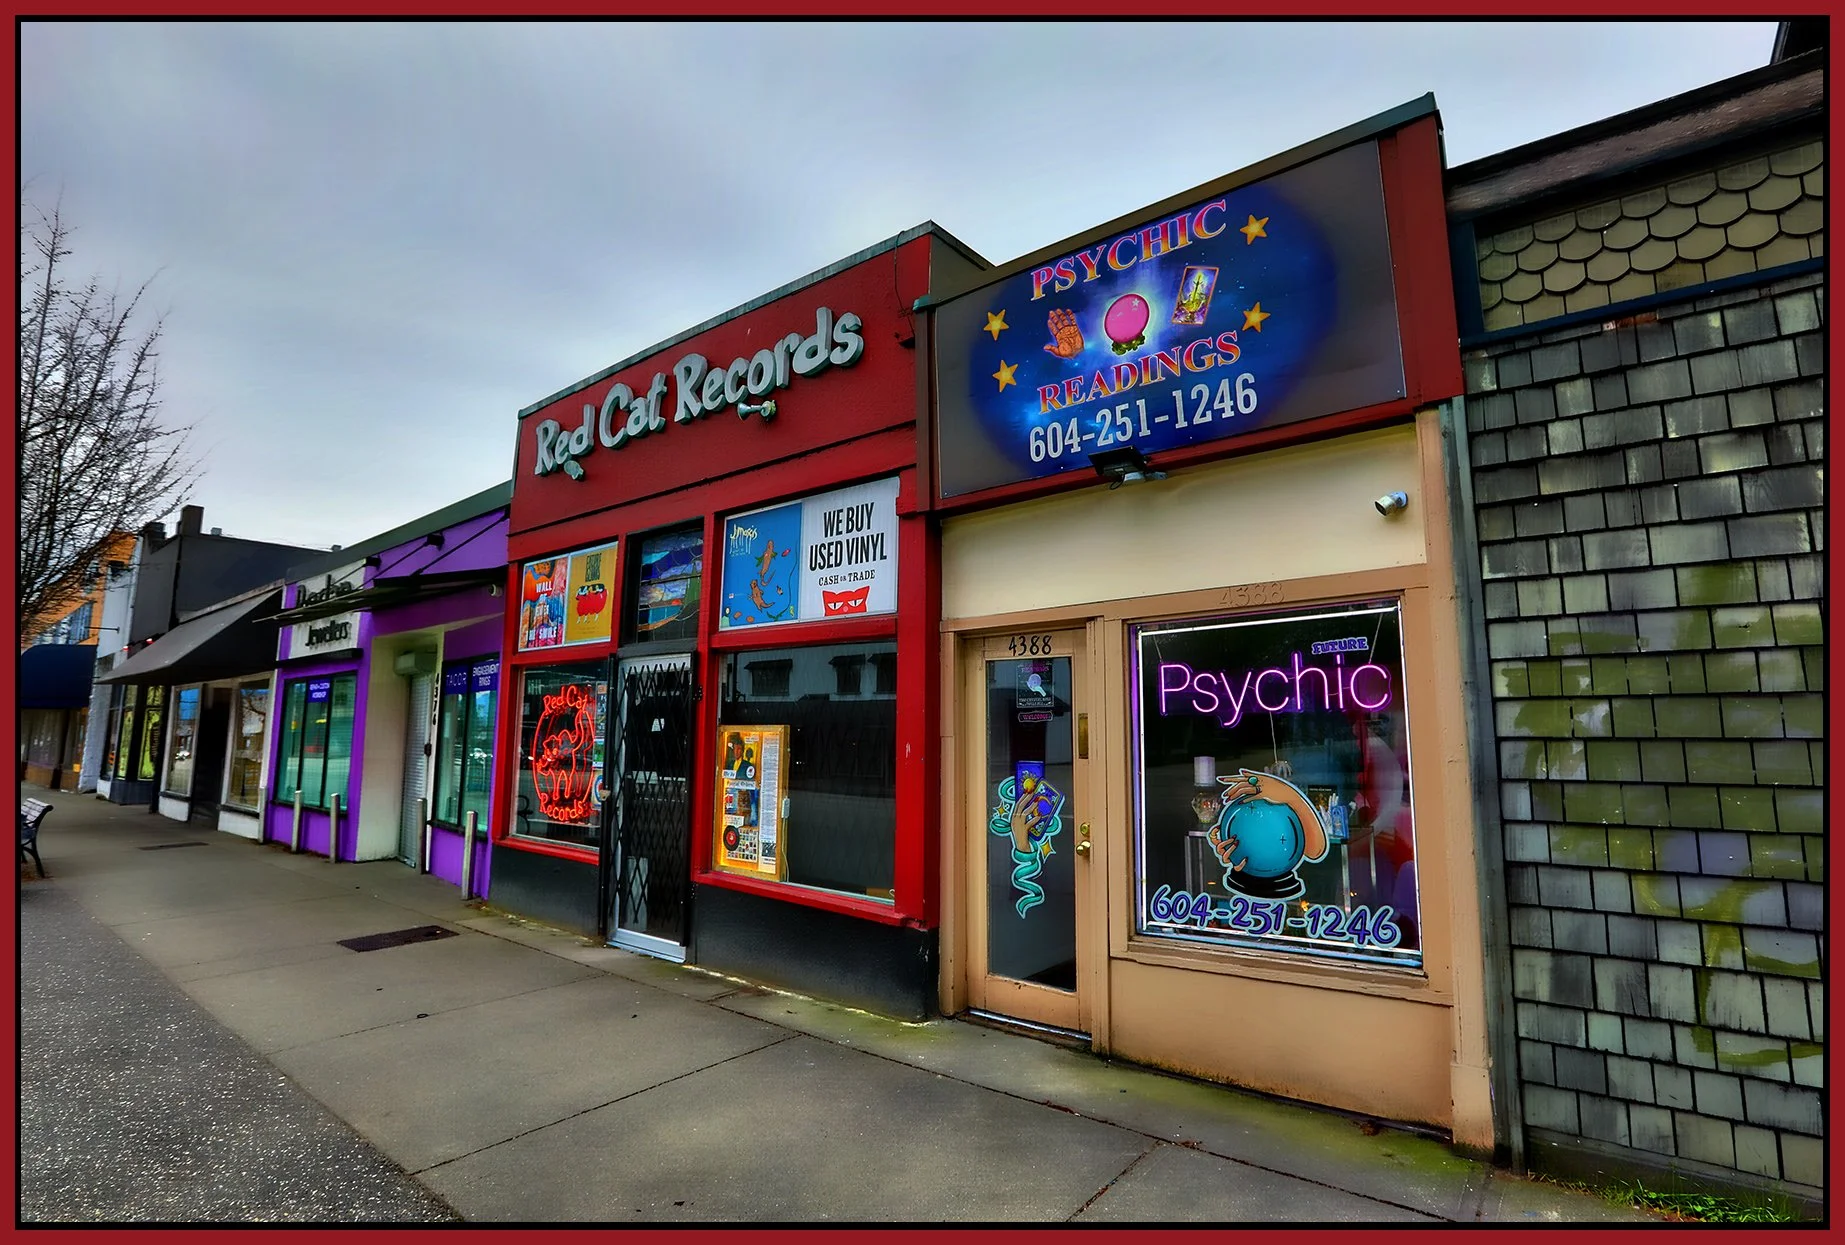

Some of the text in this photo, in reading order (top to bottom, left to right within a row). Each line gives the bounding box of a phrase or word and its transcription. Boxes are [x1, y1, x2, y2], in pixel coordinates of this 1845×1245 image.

[1030, 199, 1227, 301] PSYCHIC
[1037, 331, 1241, 414] READINGS
[535, 306, 865, 477] Red Cat Records
[1029, 373, 1257, 462] 604-251-1246
[823, 502, 875, 538] WE BUY
[809, 532, 887, 572] USED VINYL
[536, 581, 553, 593] WALL
[818, 574, 839, 586] CASH
[848, 569, 876, 582] TRADE
[1219, 581, 1285, 608] 4388
[539, 626, 557, 640] SMILE
[1008, 635, 1052, 656] 4388
[1312, 637, 1369, 655] FUTURE
[543, 686, 565, 713] Red
[567, 685, 588, 711] Cat
[1160, 652, 1390, 727] Psychic
[540, 792, 583, 821] Records
[1152, 885, 1401, 947] 604-251-1246
